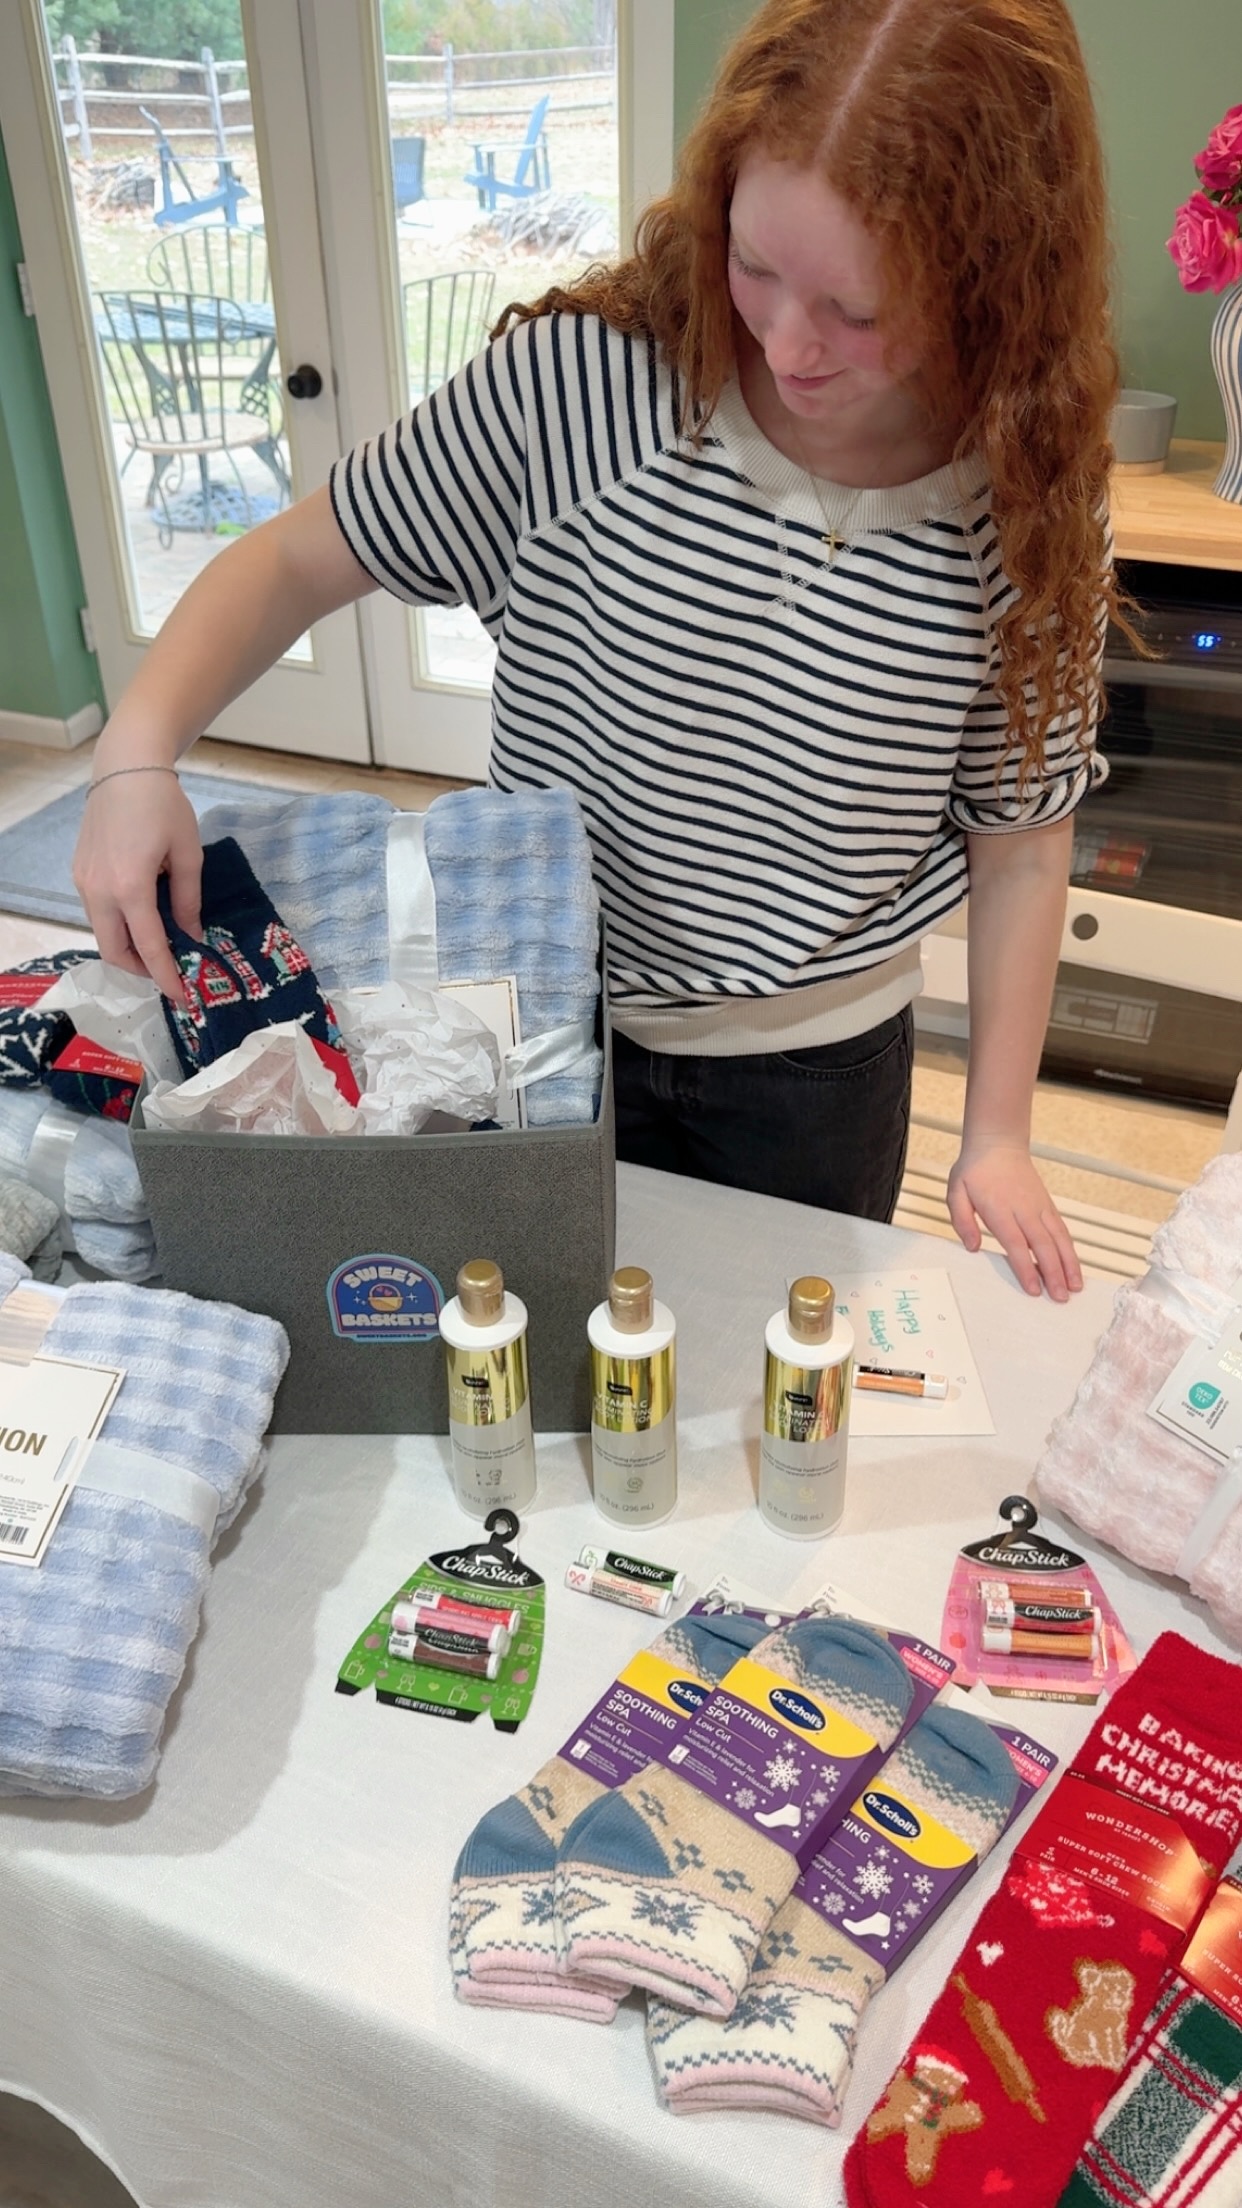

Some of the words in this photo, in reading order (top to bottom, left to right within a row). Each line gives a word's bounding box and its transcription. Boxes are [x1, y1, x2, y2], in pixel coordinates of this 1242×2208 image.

[342, 1265, 423, 1289] SWEET
[341, 1312, 437, 1327] BASKETS
[892, 1289, 923, 1335] Happy
[867, 1309, 896, 1353] Holidays
[0, 1426, 48, 1456] ION
[441, 1555, 525, 1586] ChapStick
[613, 1556, 666, 1581] ChapStick
[979, 1546, 1069, 1567] ChapStick
[1024, 1605, 1081, 1620] ChapStick
[424, 1628, 479, 1646] ChapStick
[903, 1650, 944, 1679] WOMEN'S
[913, 1643, 922, 1653] 1
[922, 1648, 951, 1671] PAIR
[605, 1699, 632, 1719] SPA
[613, 1688, 678, 1730] SOOTHING
[669, 1682, 704, 1707] Dr.Sch
[596, 1711, 616, 1728] Low
[615, 1722, 632, 1737] Cut
[705, 1705, 731, 1726] SPA
[713, 1694, 780, 1740] SOOTHING
[771, 1689, 824, 1730] Dr.Scholl's
[695, 1717, 716, 1733] Low
[714, 1728, 733, 1743] Cut
[688, 1727, 710, 1746] Vitamin
[721, 1745, 748, 1768] lavender
[747, 1763, 757, 1774] for
[1011, 1735, 1021, 1747] 1
[1021, 1742, 1051, 1767] PAIR
[1138, 1712, 1242, 1781] BAKING
[683, 1734, 718, 1763] moisturizing
[717, 1753, 734, 1772] relief
[732, 1764, 747, 1778] and
[745, 1771, 775, 1798] relaxation
[1007, 1748, 1043, 1777] OMEN'S
[865, 1794, 919, 1837] Dr.Scholl's
[841, 1818, 872, 1844] HING
[1085, 1811, 1175, 1857] WONDERSHOP
[1057, 1835, 1088, 1853] SUPER
[1087, 1849, 1112, 1863] SOFT
[1112, 1860, 1141, 1877] CREW
[822, 1869, 836, 1881] and
[833, 1876, 865, 1905] relaxation
[835, 1868, 847, 1878] for
[1073, 1866, 1093, 1880] MEN'S
[1202, 1948, 1233, 1976] SUPER
